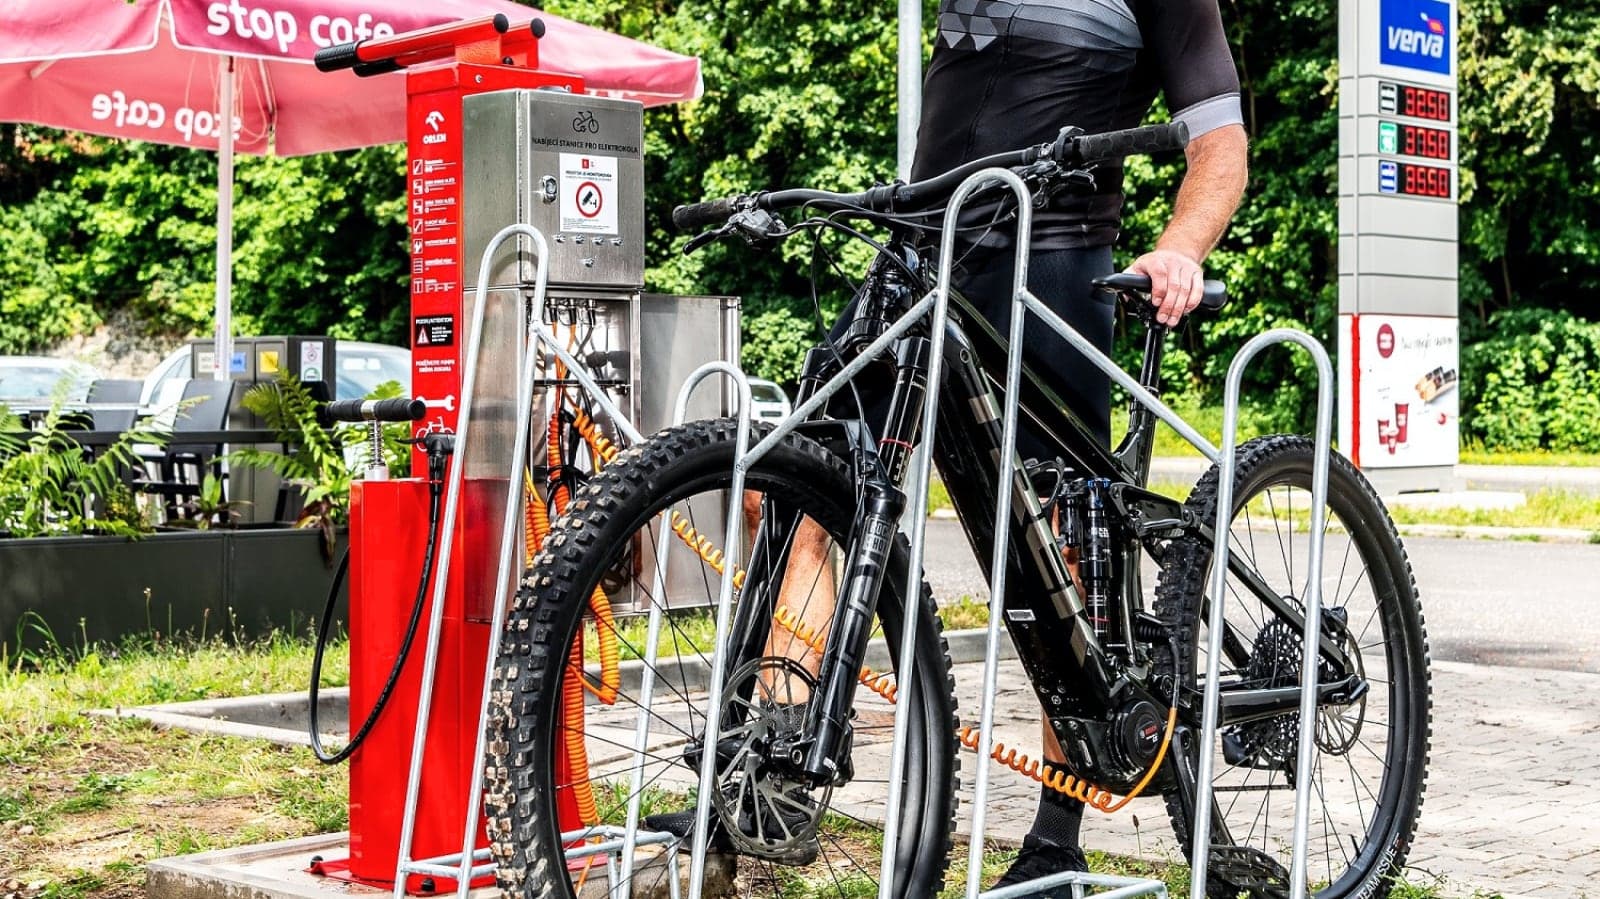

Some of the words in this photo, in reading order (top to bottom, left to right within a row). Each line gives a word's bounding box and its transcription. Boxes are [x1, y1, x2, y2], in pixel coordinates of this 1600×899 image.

[207, 0, 297, 53] stop
[1388, 26, 1444, 59] verva
[423, 133, 447, 144] ORLEN
[560, 139, 584, 149] STANICE
[585, 141, 597, 150] PRO
[598, 143, 638, 153] ELEKTROKOLA
[1375, 845, 1398, 878] ISSUE
